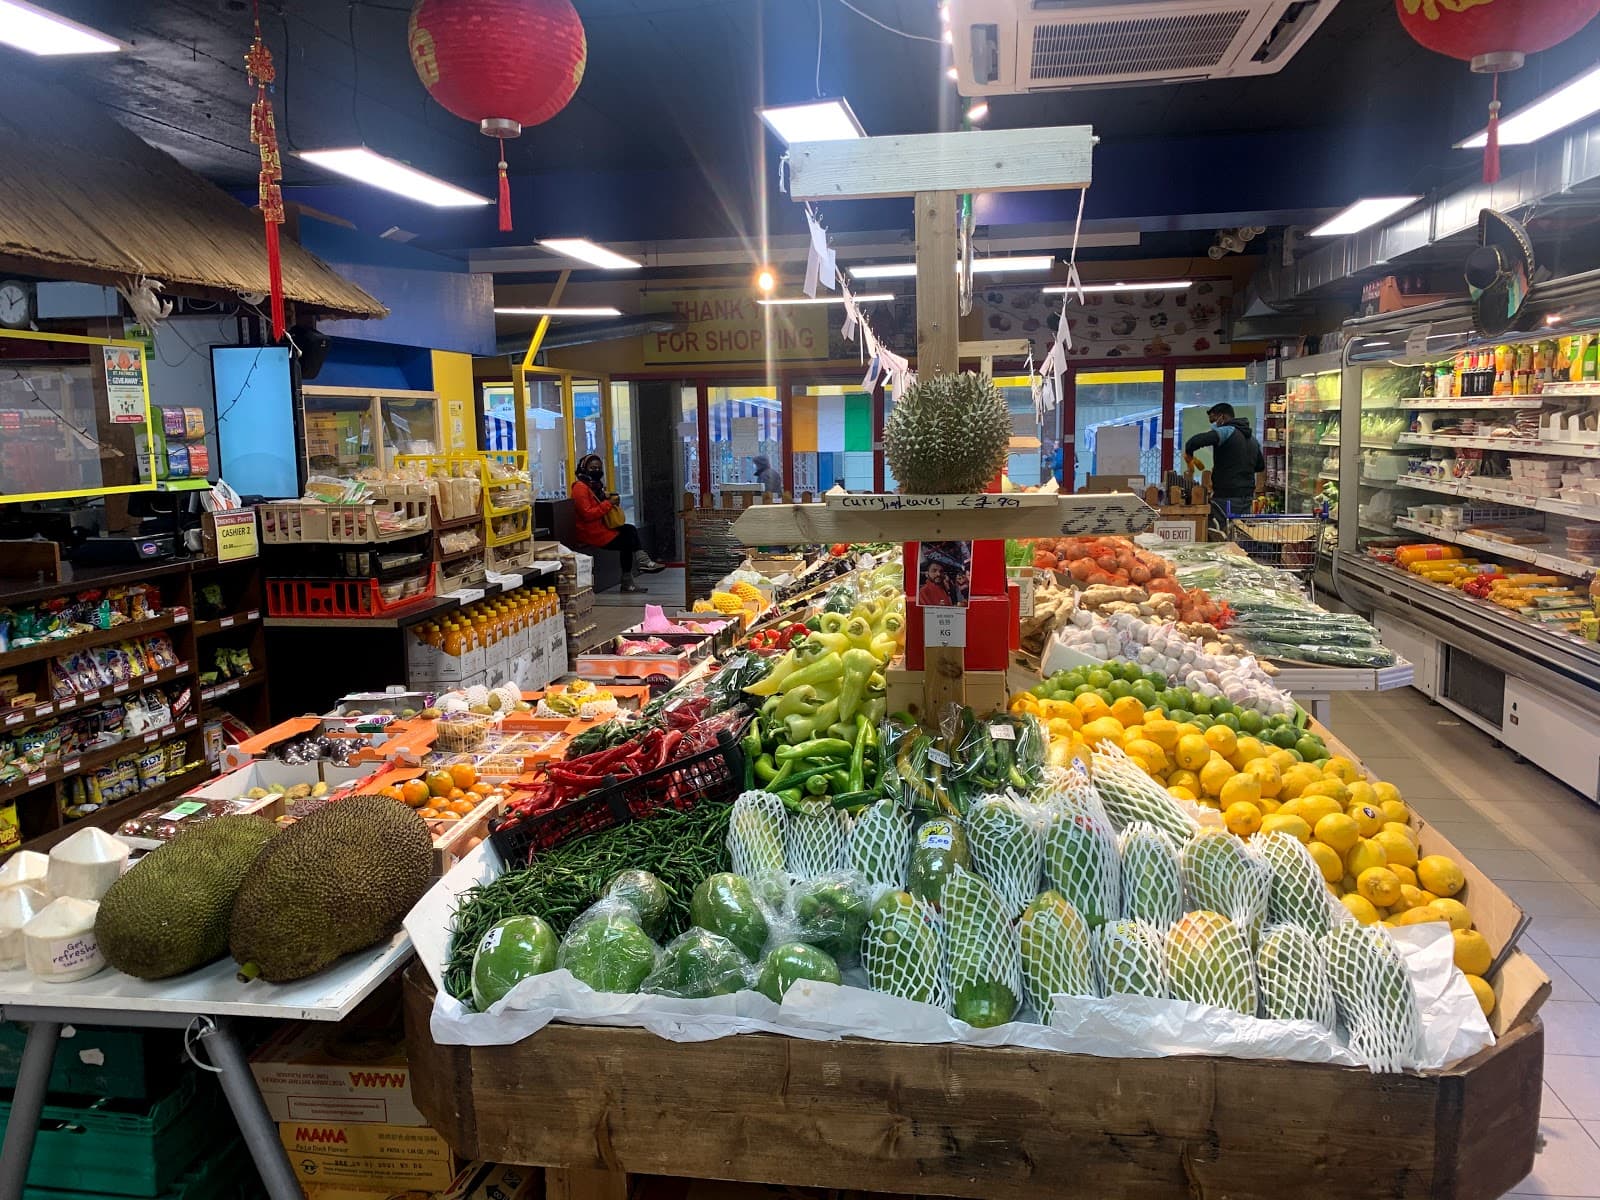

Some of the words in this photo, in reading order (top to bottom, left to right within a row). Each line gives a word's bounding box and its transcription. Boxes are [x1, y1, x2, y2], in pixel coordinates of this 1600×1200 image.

[671, 301, 744, 322] THANK
[656, 332, 700, 353] FOR
[705, 328, 815, 352] SHOPING
[222, 528, 246, 538] CASHIER
[246, 526, 251, 535] 2
[1159, 530, 1170, 540] NO
[1172, 530, 1188, 540] EXIT
[940, 629, 951, 637] KG
[141, 753, 162, 769] BOY
[53, 943, 97, 963] refreshe
[67, 941, 84, 951] Get
[350, 1071, 407, 1088] MAMA
[295, 1127, 348, 1144] MAMA
